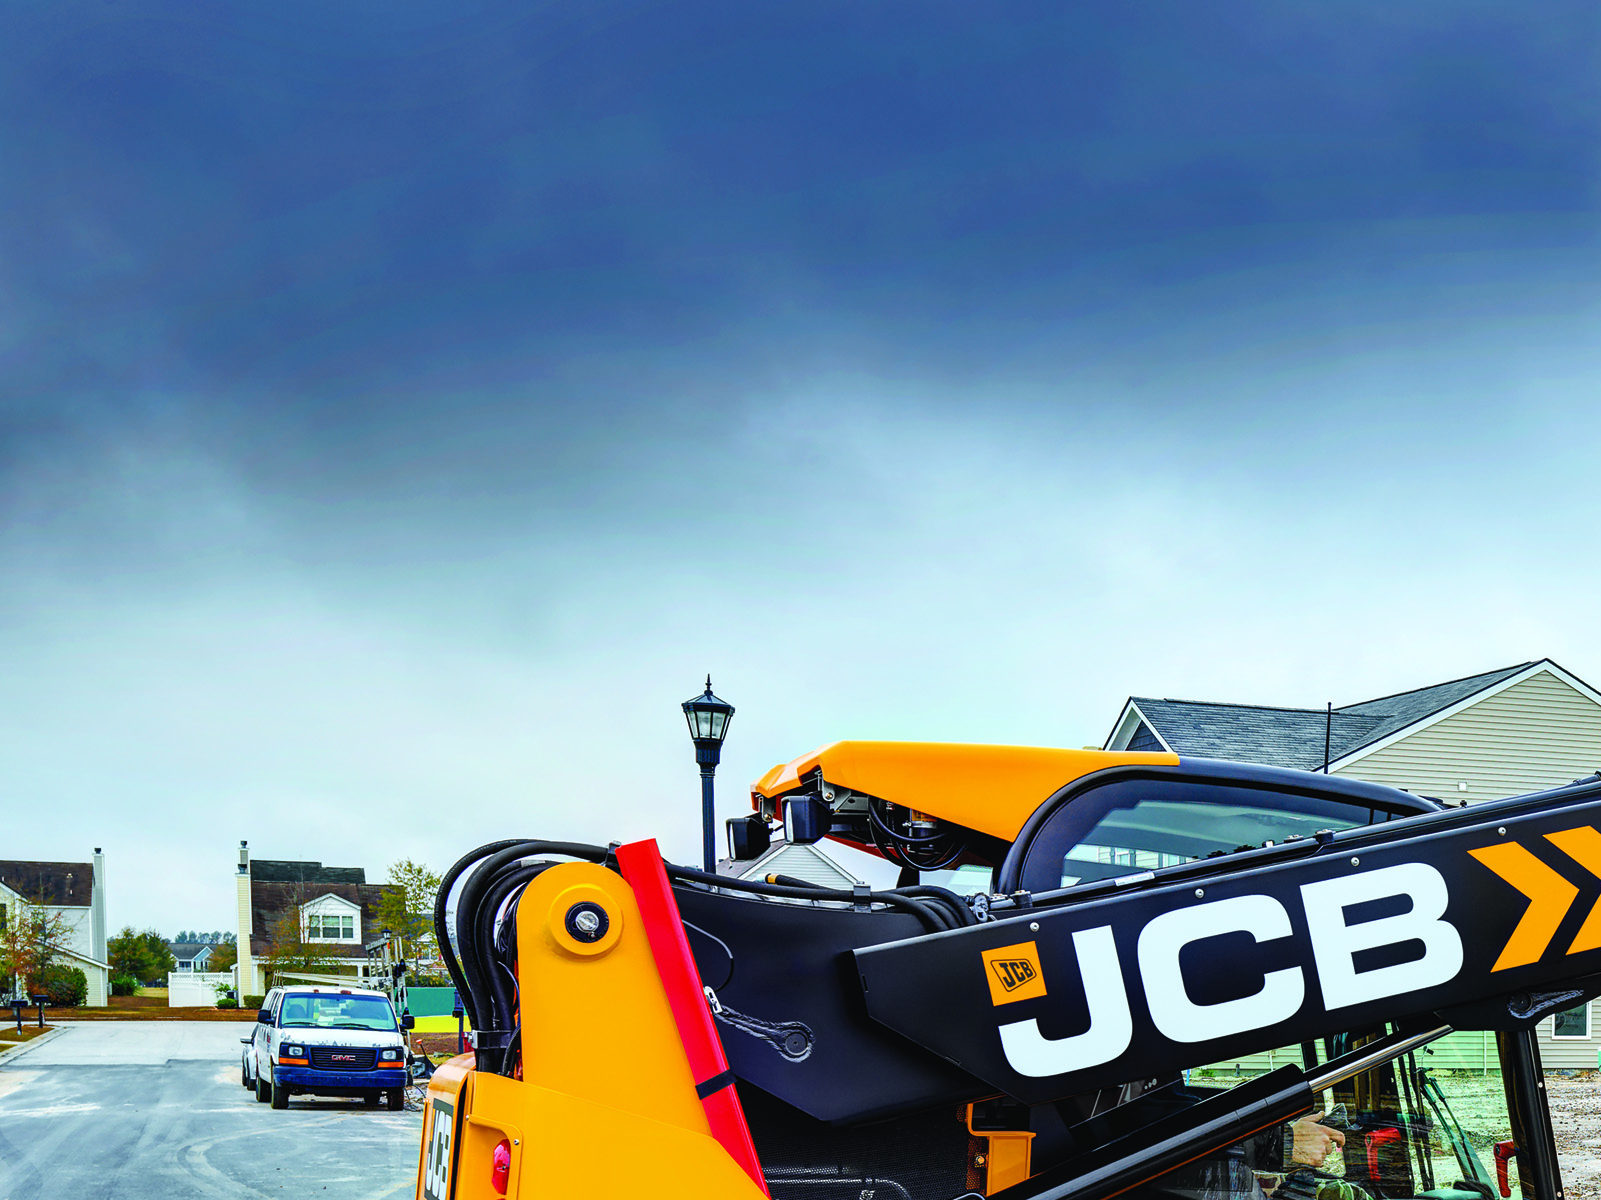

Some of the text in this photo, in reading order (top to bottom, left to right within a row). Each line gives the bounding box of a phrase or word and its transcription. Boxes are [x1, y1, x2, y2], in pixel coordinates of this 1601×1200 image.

[998, 861, 1464, 1078] JCB
[998, 959, 1035, 989] JCB
[331, 1054, 356, 1062] GMC
